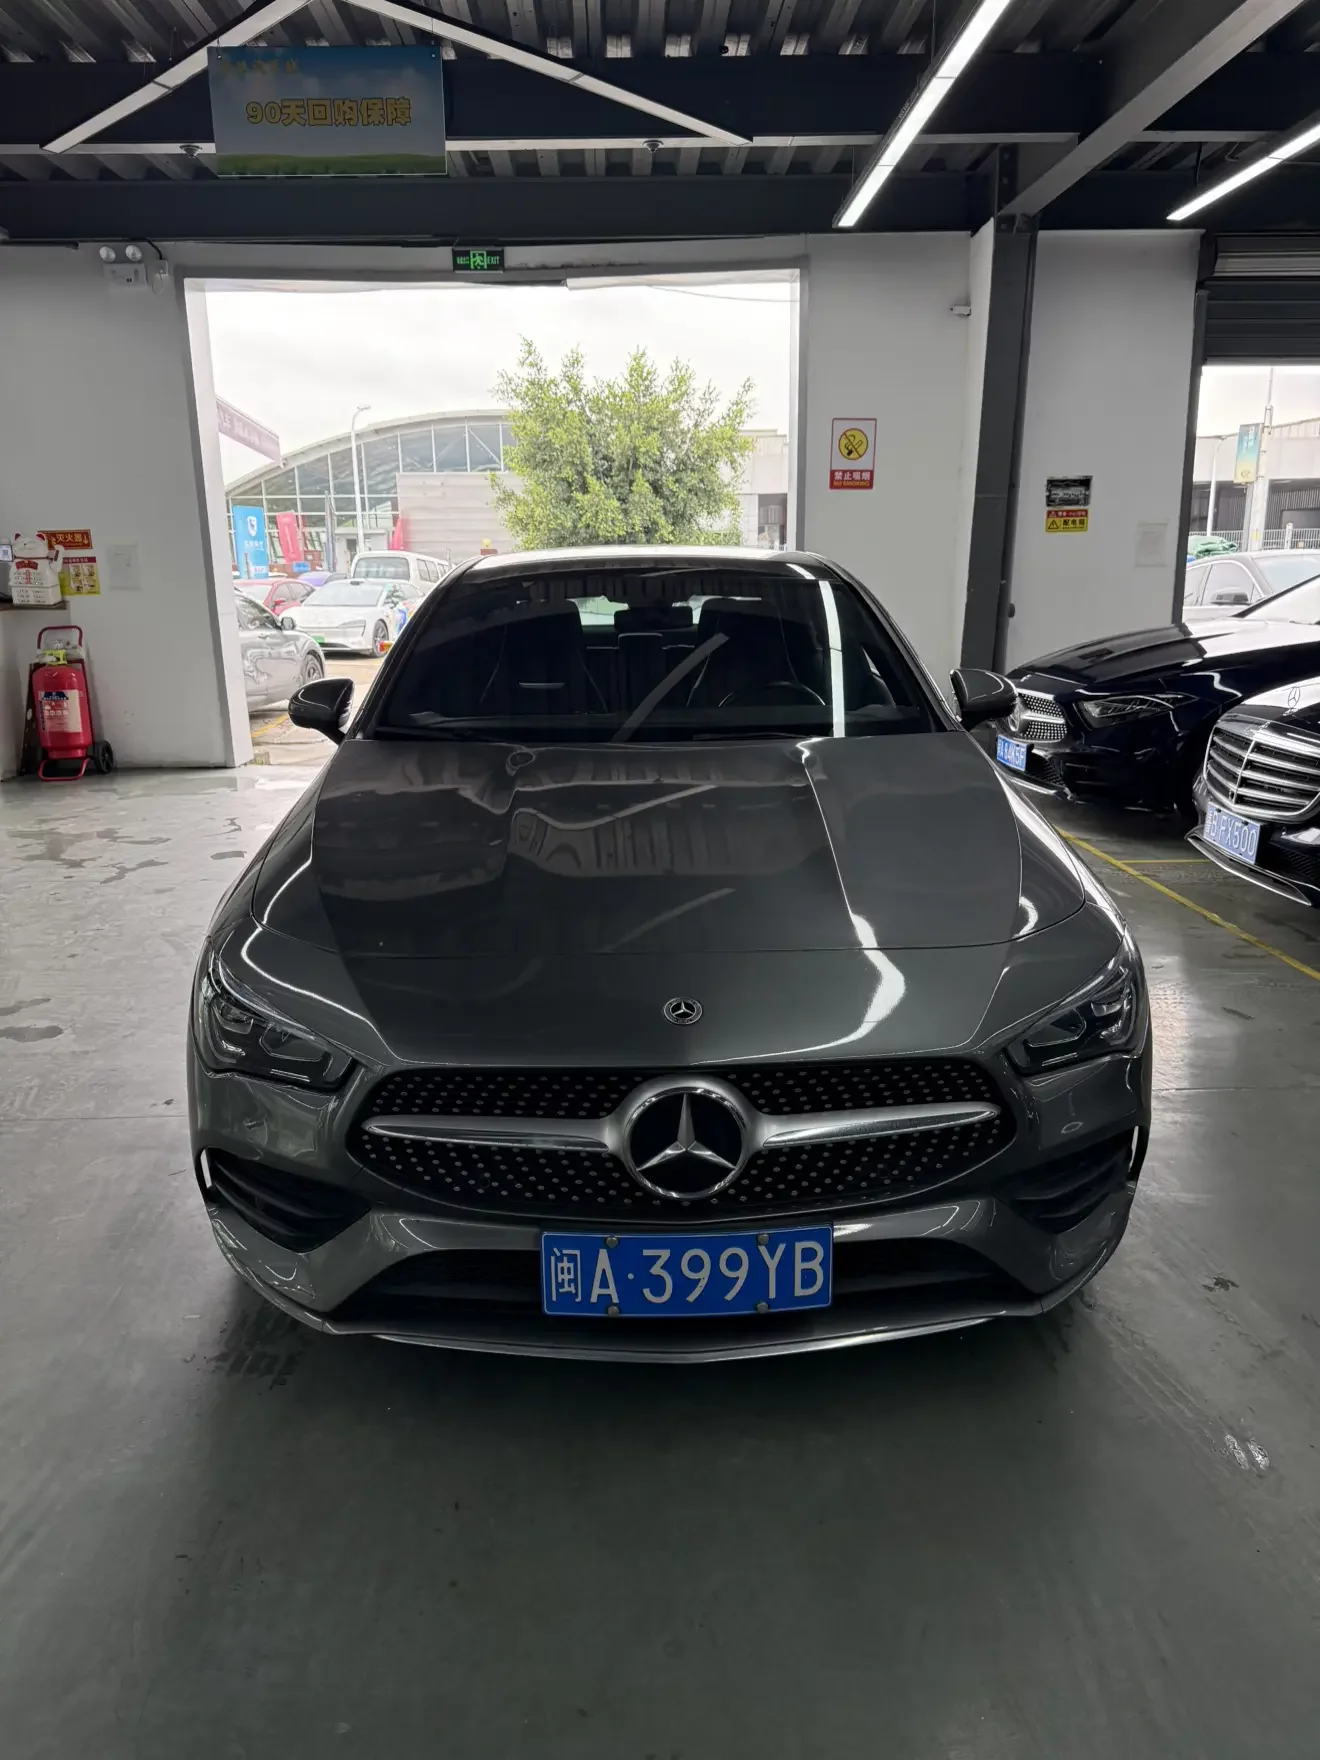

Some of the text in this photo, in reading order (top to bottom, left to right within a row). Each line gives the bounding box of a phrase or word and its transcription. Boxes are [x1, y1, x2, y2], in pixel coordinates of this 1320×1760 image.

[245, 97, 413, 127] 90天回购保障
[487, 256, 500, 265] EXIT
[834, 471, 871, 480] 禁止吸烟
[551, 1241, 824, 1304] 闽A·399YB
